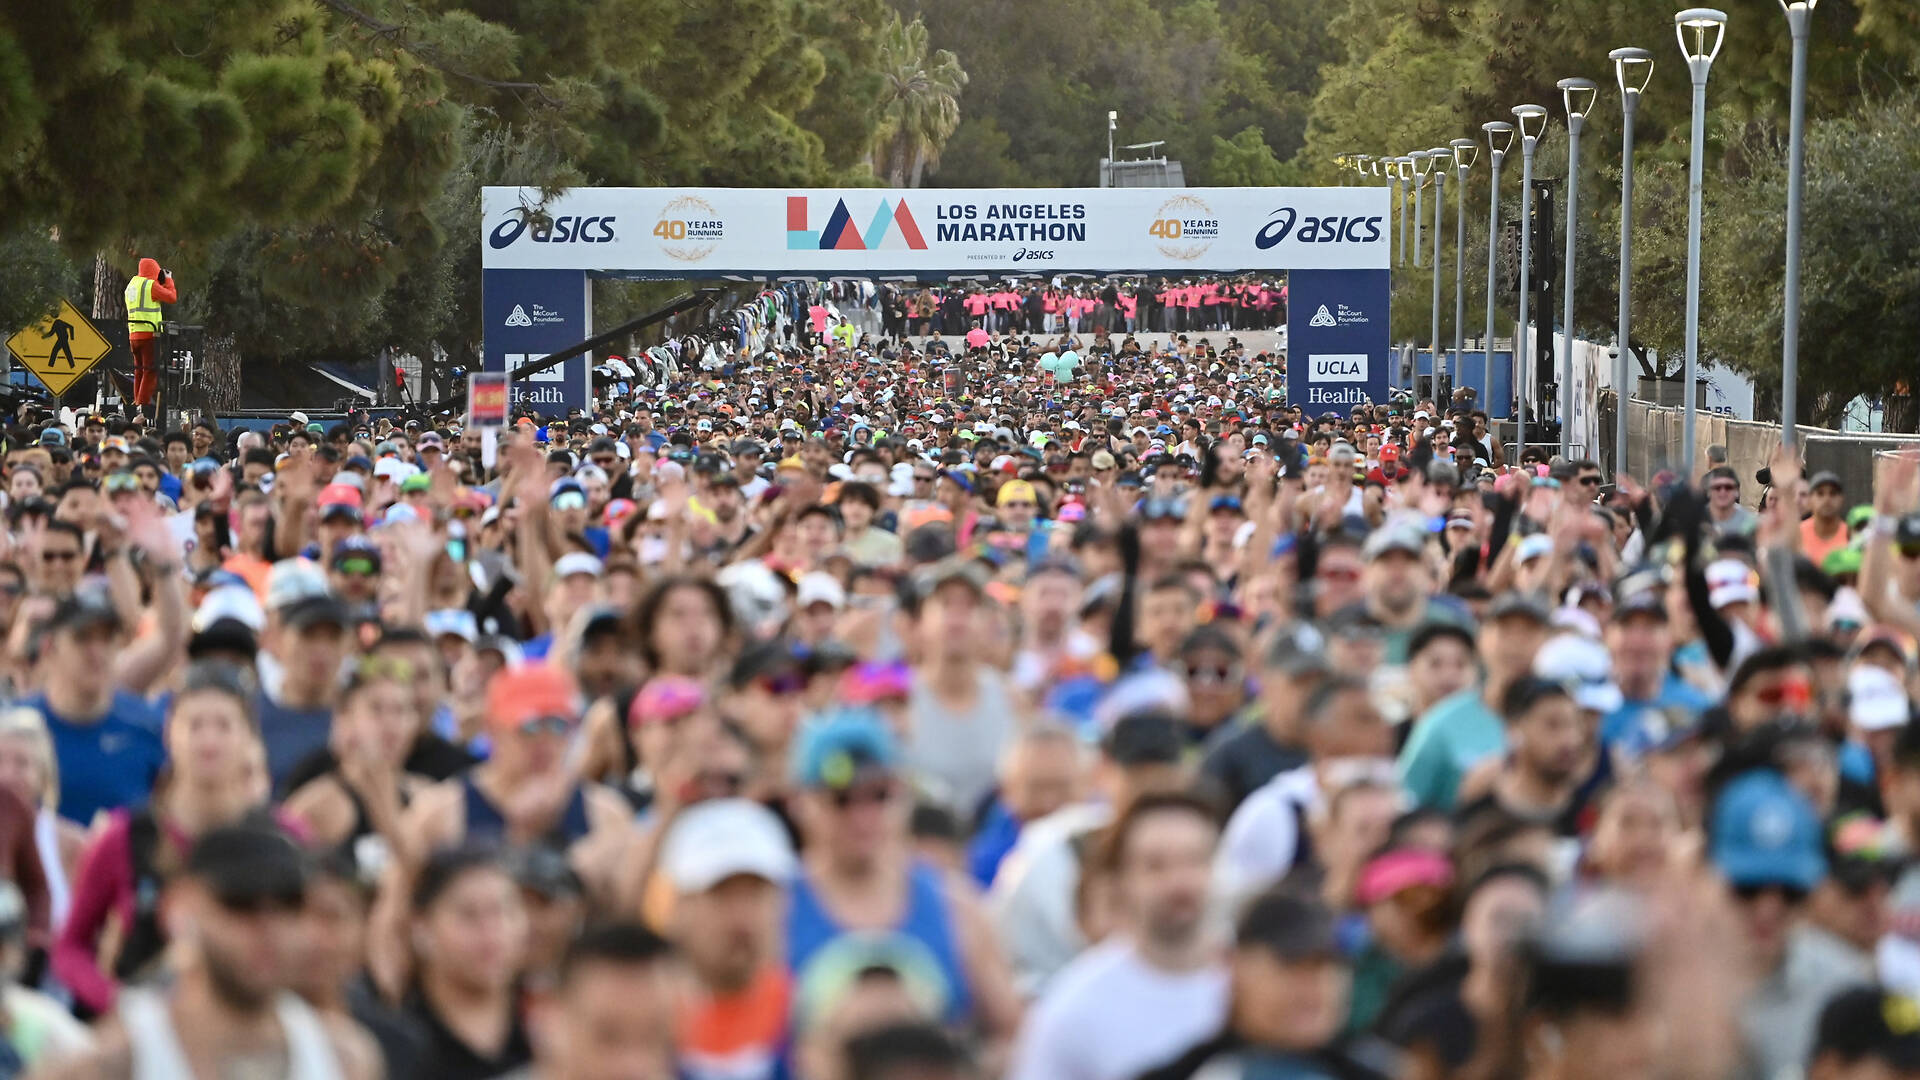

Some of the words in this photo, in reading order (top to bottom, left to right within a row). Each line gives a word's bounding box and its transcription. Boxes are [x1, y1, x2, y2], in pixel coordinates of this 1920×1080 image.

[937, 204, 977, 219] LOS
[986, 204, 1085, 219] ANGELES
[653, 220, 685, 240] 40
[687, 221, 723, 229] YEARS
[937, 223, 1086, 241] MARATHON
[1149, 219, 1181, 239] 40
[1317, 361, 1360, 375] UCLA
[1308, 387, 1367, 403] Health
